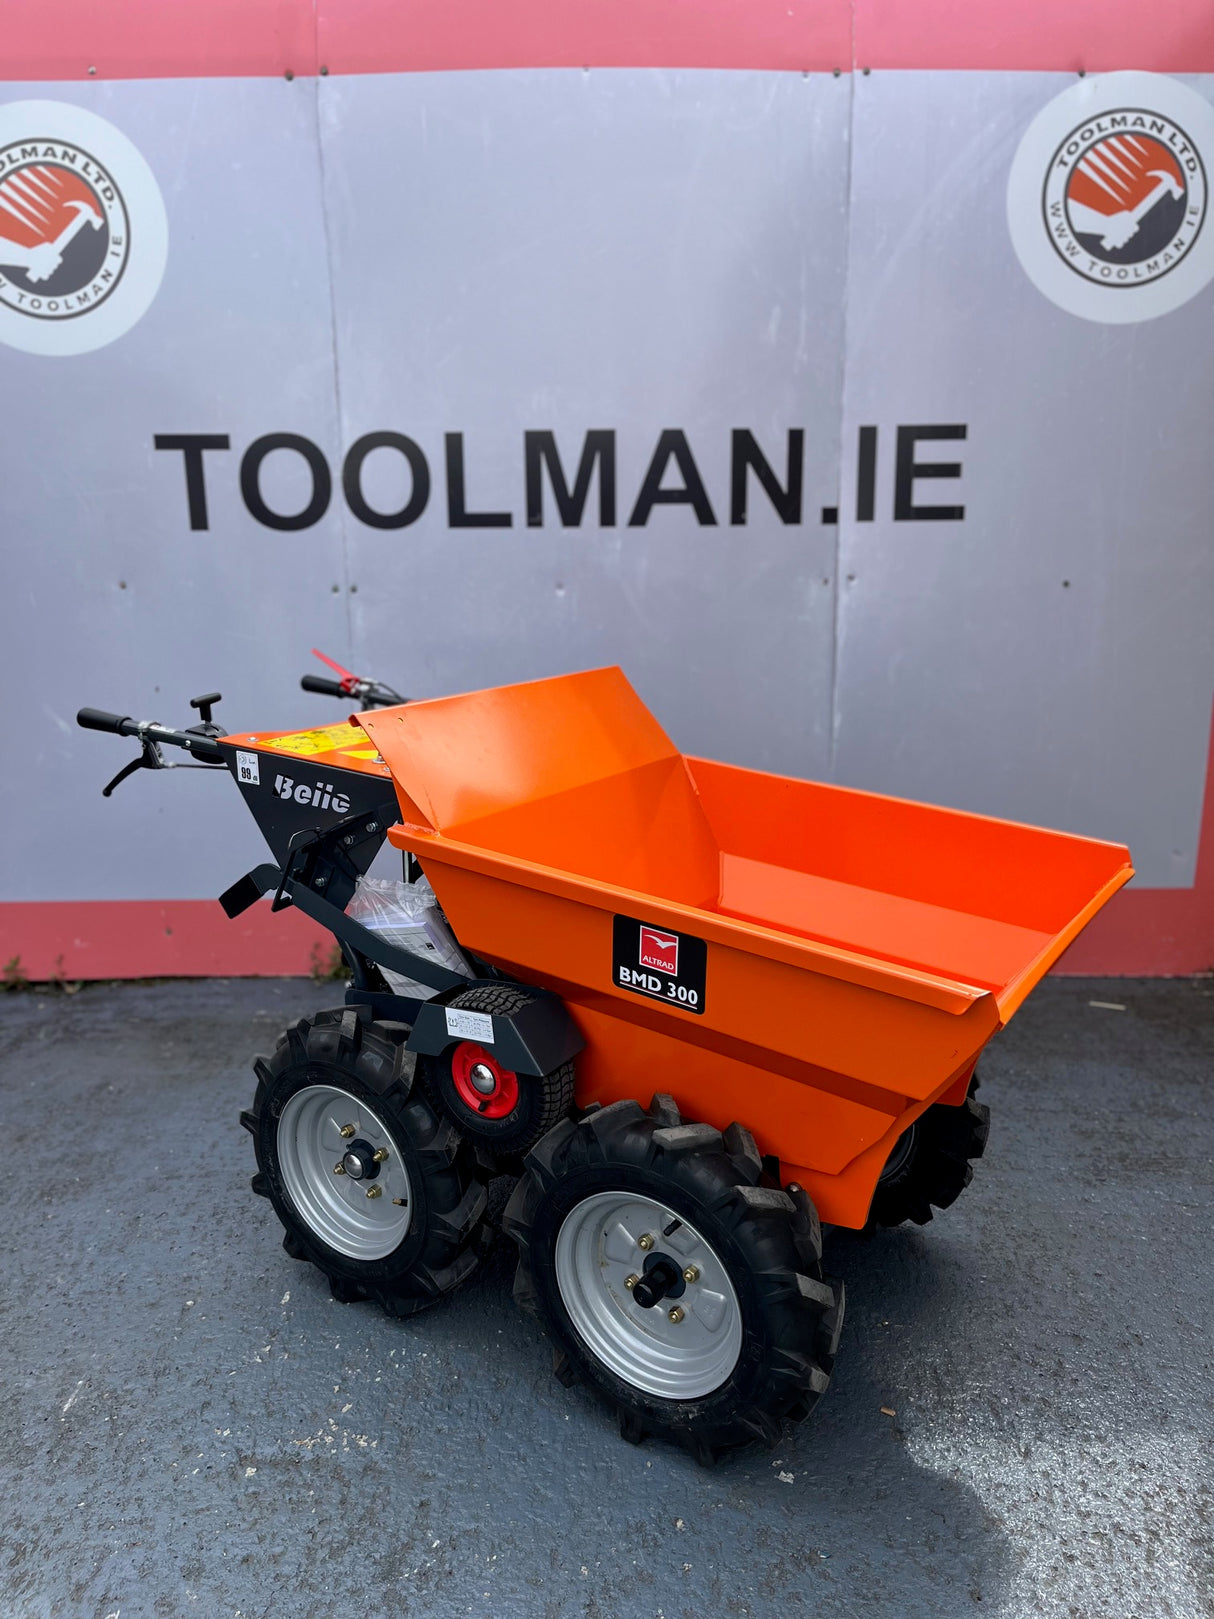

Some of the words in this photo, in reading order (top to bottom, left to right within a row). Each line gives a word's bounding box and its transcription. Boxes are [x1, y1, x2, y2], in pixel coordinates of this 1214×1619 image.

[1057, 116, 1165, 169] TOOLMAN
[1168, 132, 1198, 180] LTD.
[81, 162, 115, 209] LTD.
[154, 424, 967, 531] TOOLMAN.IE
[241, 767, 251, 779] 99
[642, 955, 674, 970] ALTRAD
[619, 966, 662, 992] BMD
[667, 982, 698, 1005] 300
